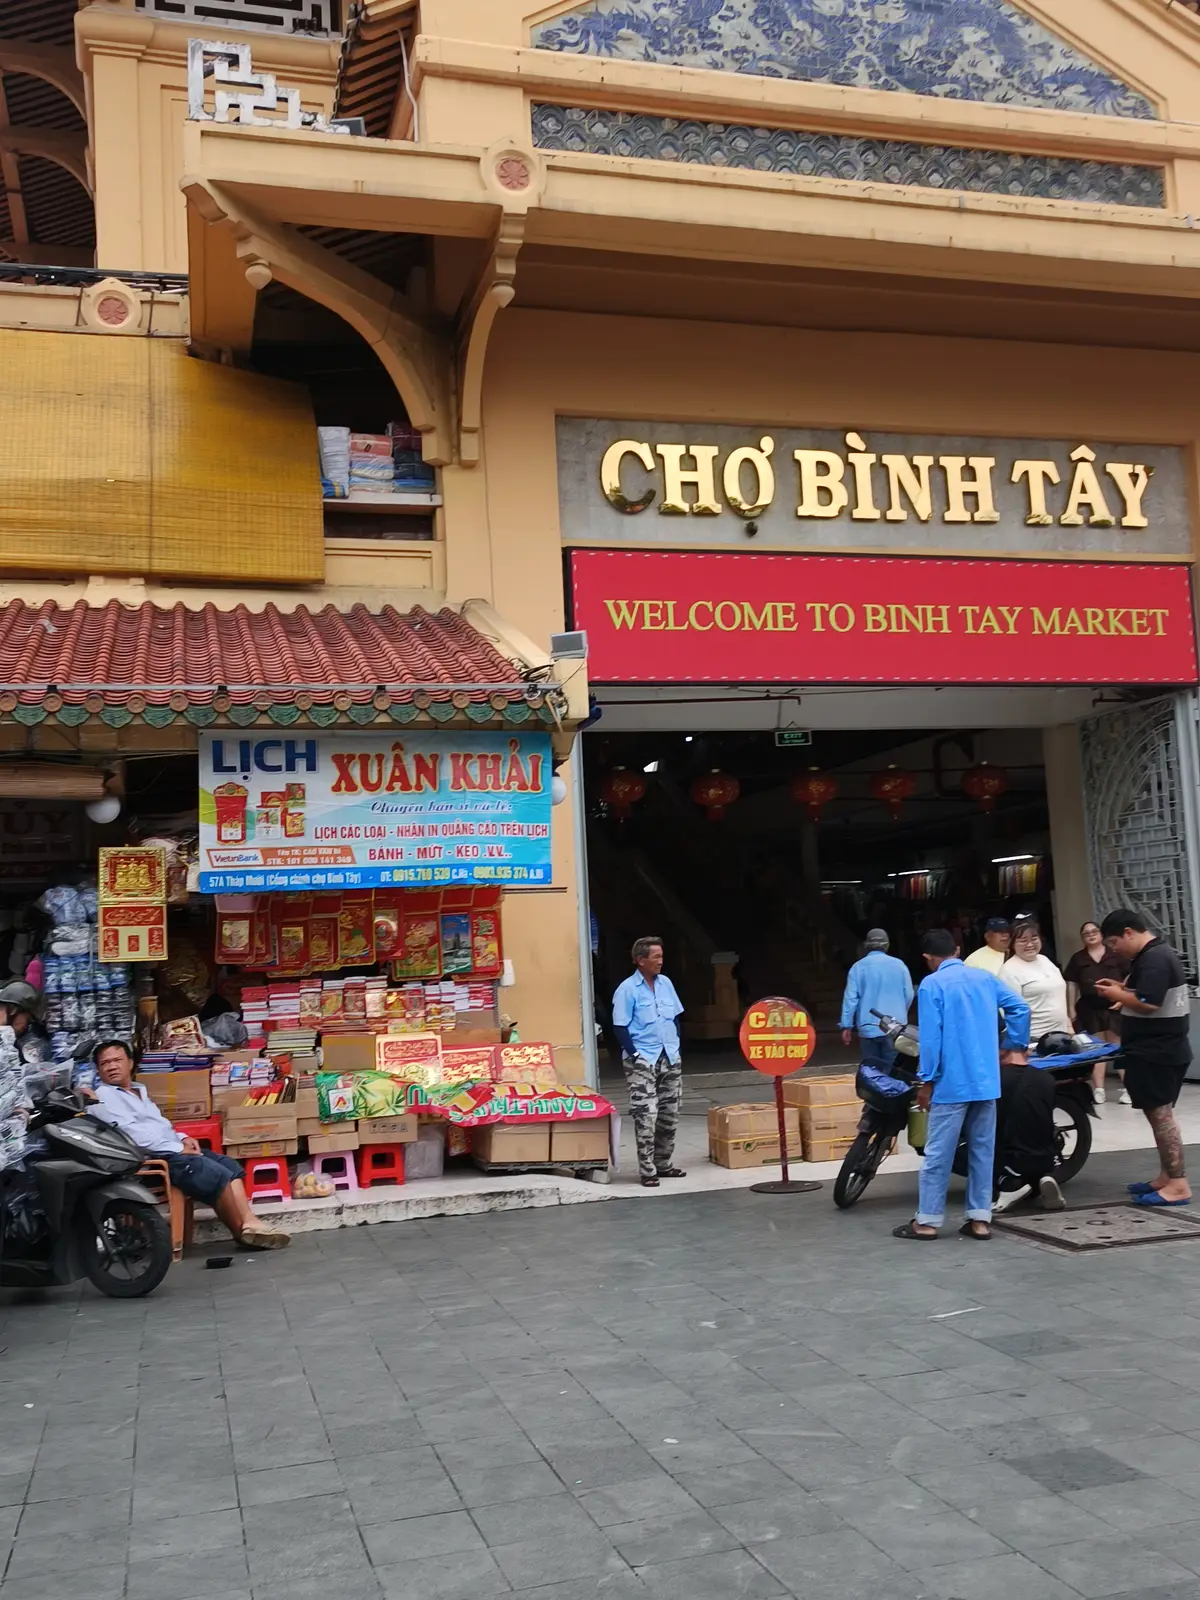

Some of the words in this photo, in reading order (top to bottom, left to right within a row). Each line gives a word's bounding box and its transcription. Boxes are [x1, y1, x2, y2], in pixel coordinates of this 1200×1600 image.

[600, 435, 775, 537] CHỢ
[794, 432, 1000, 523] BÌNH
[1011, 444, 1154, 528] TÂY
[604, 600, 799, 633] WELCOME
[806, 602, 856, 633] TO
[864, 604, 950, 634] BINH
[959, 606, 1022, 636] TAY
[1031, 607, 1169, 637] MARKET
[211, 739, 317, 781] LỊCH
[331, 742, 440, 793] XUÂN
[450, 738, 543, 792] KHẢI
[314, 826, 337, 842] LỊCH
[341, 823, 361, 839] CÁC
[364, 825, 386, 841] LOẠI
[397, 822, 425, 840] NHẬN
[428, 824, 438, 837] IN
[478, 820, 497, 835] CÁO
[501, 821, 523, 836] TRÊN
[527, 824, 548, 840] LỊCH
[368, 845, 403, 860] BÁNH
[456, 845, 479, 861] KẸO
[209, 876, 224, 887] 57A
[748, 1006, 807, 1028] CẤM
[749, 1046, 763, 1059] XE
[787, 1044, 808, 1060] CHỢ
